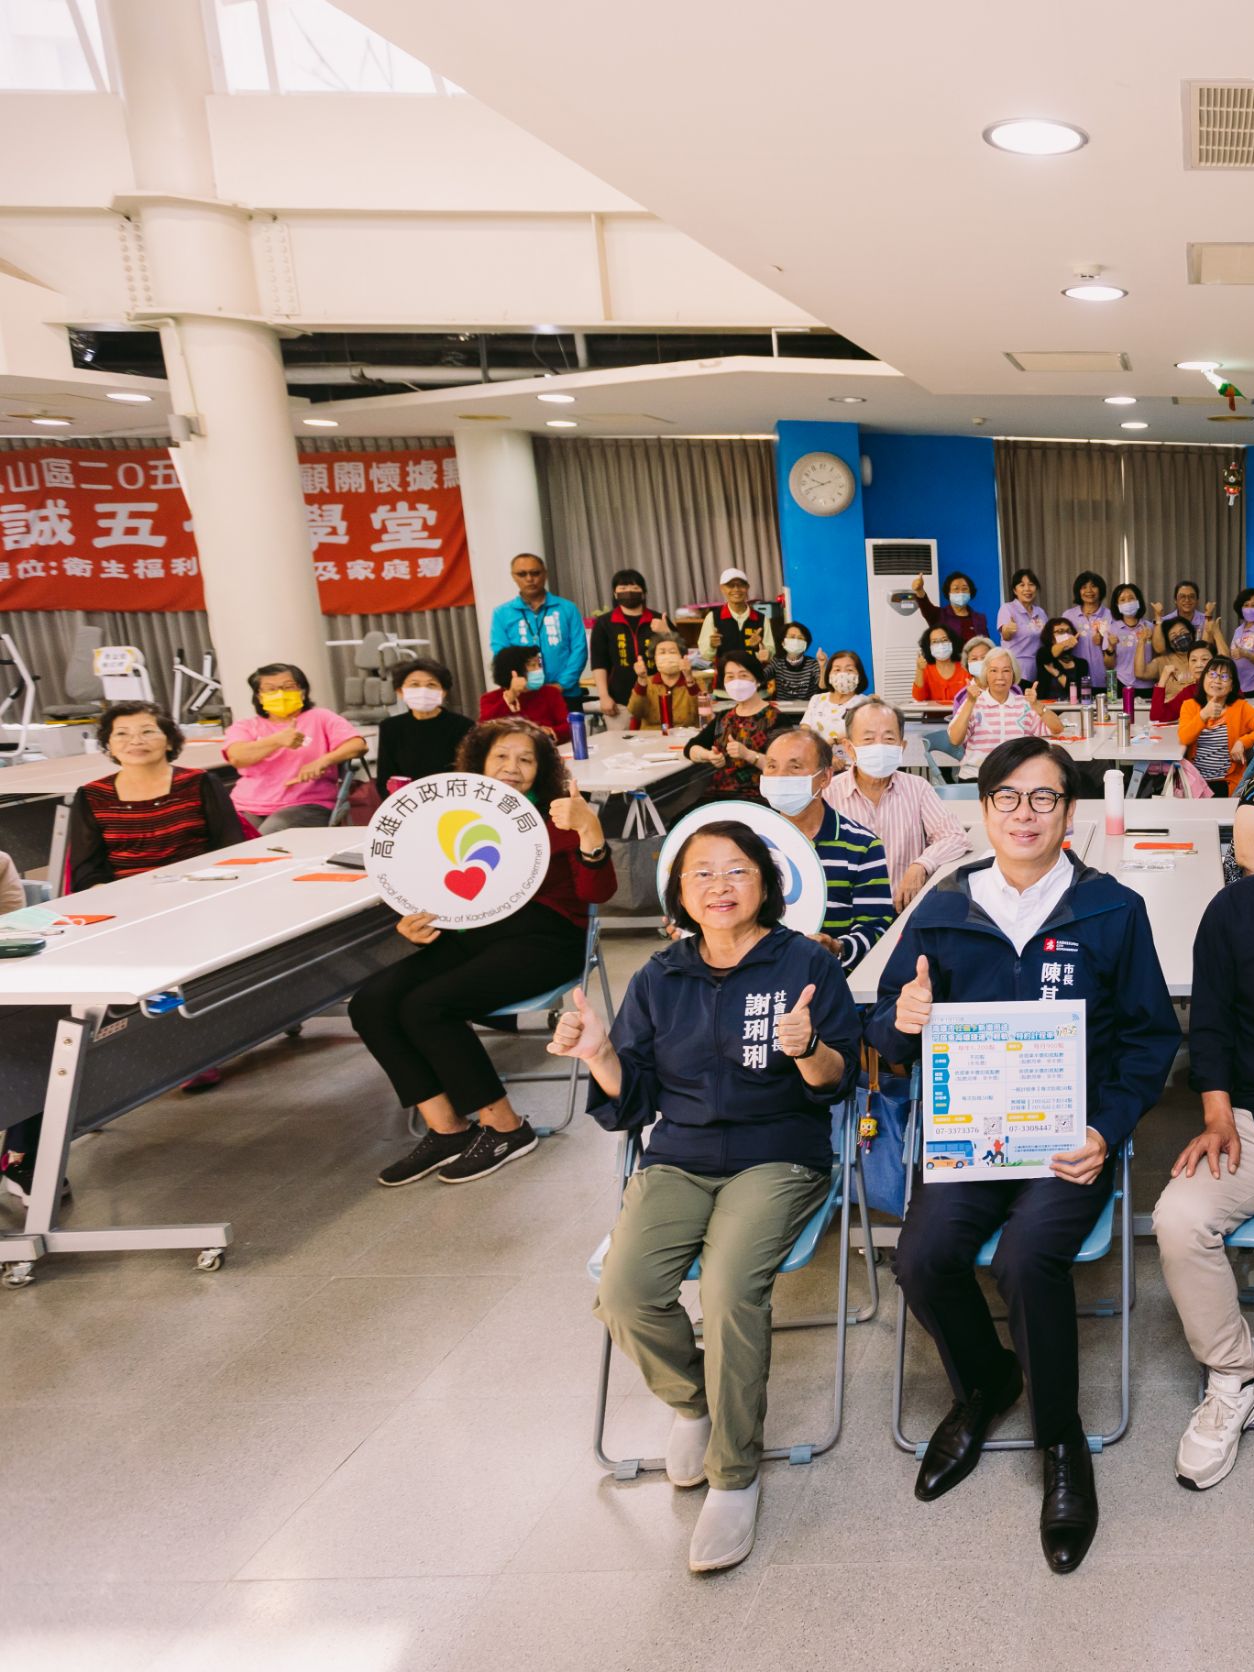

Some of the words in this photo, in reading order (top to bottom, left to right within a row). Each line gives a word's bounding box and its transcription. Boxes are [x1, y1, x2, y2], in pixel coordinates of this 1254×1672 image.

[370, 778, 538, 859] 高雄市政府社會局
[377, 872, 396, 898] Social
[465, 900, 512, 923] Kaohsiung
[508, 890, 526, 905] City
[521, 842, 544, 890] Government
[1062, 962, 1076, 987] 市長
[742, 992, 772, 1069] 謝琍琍
